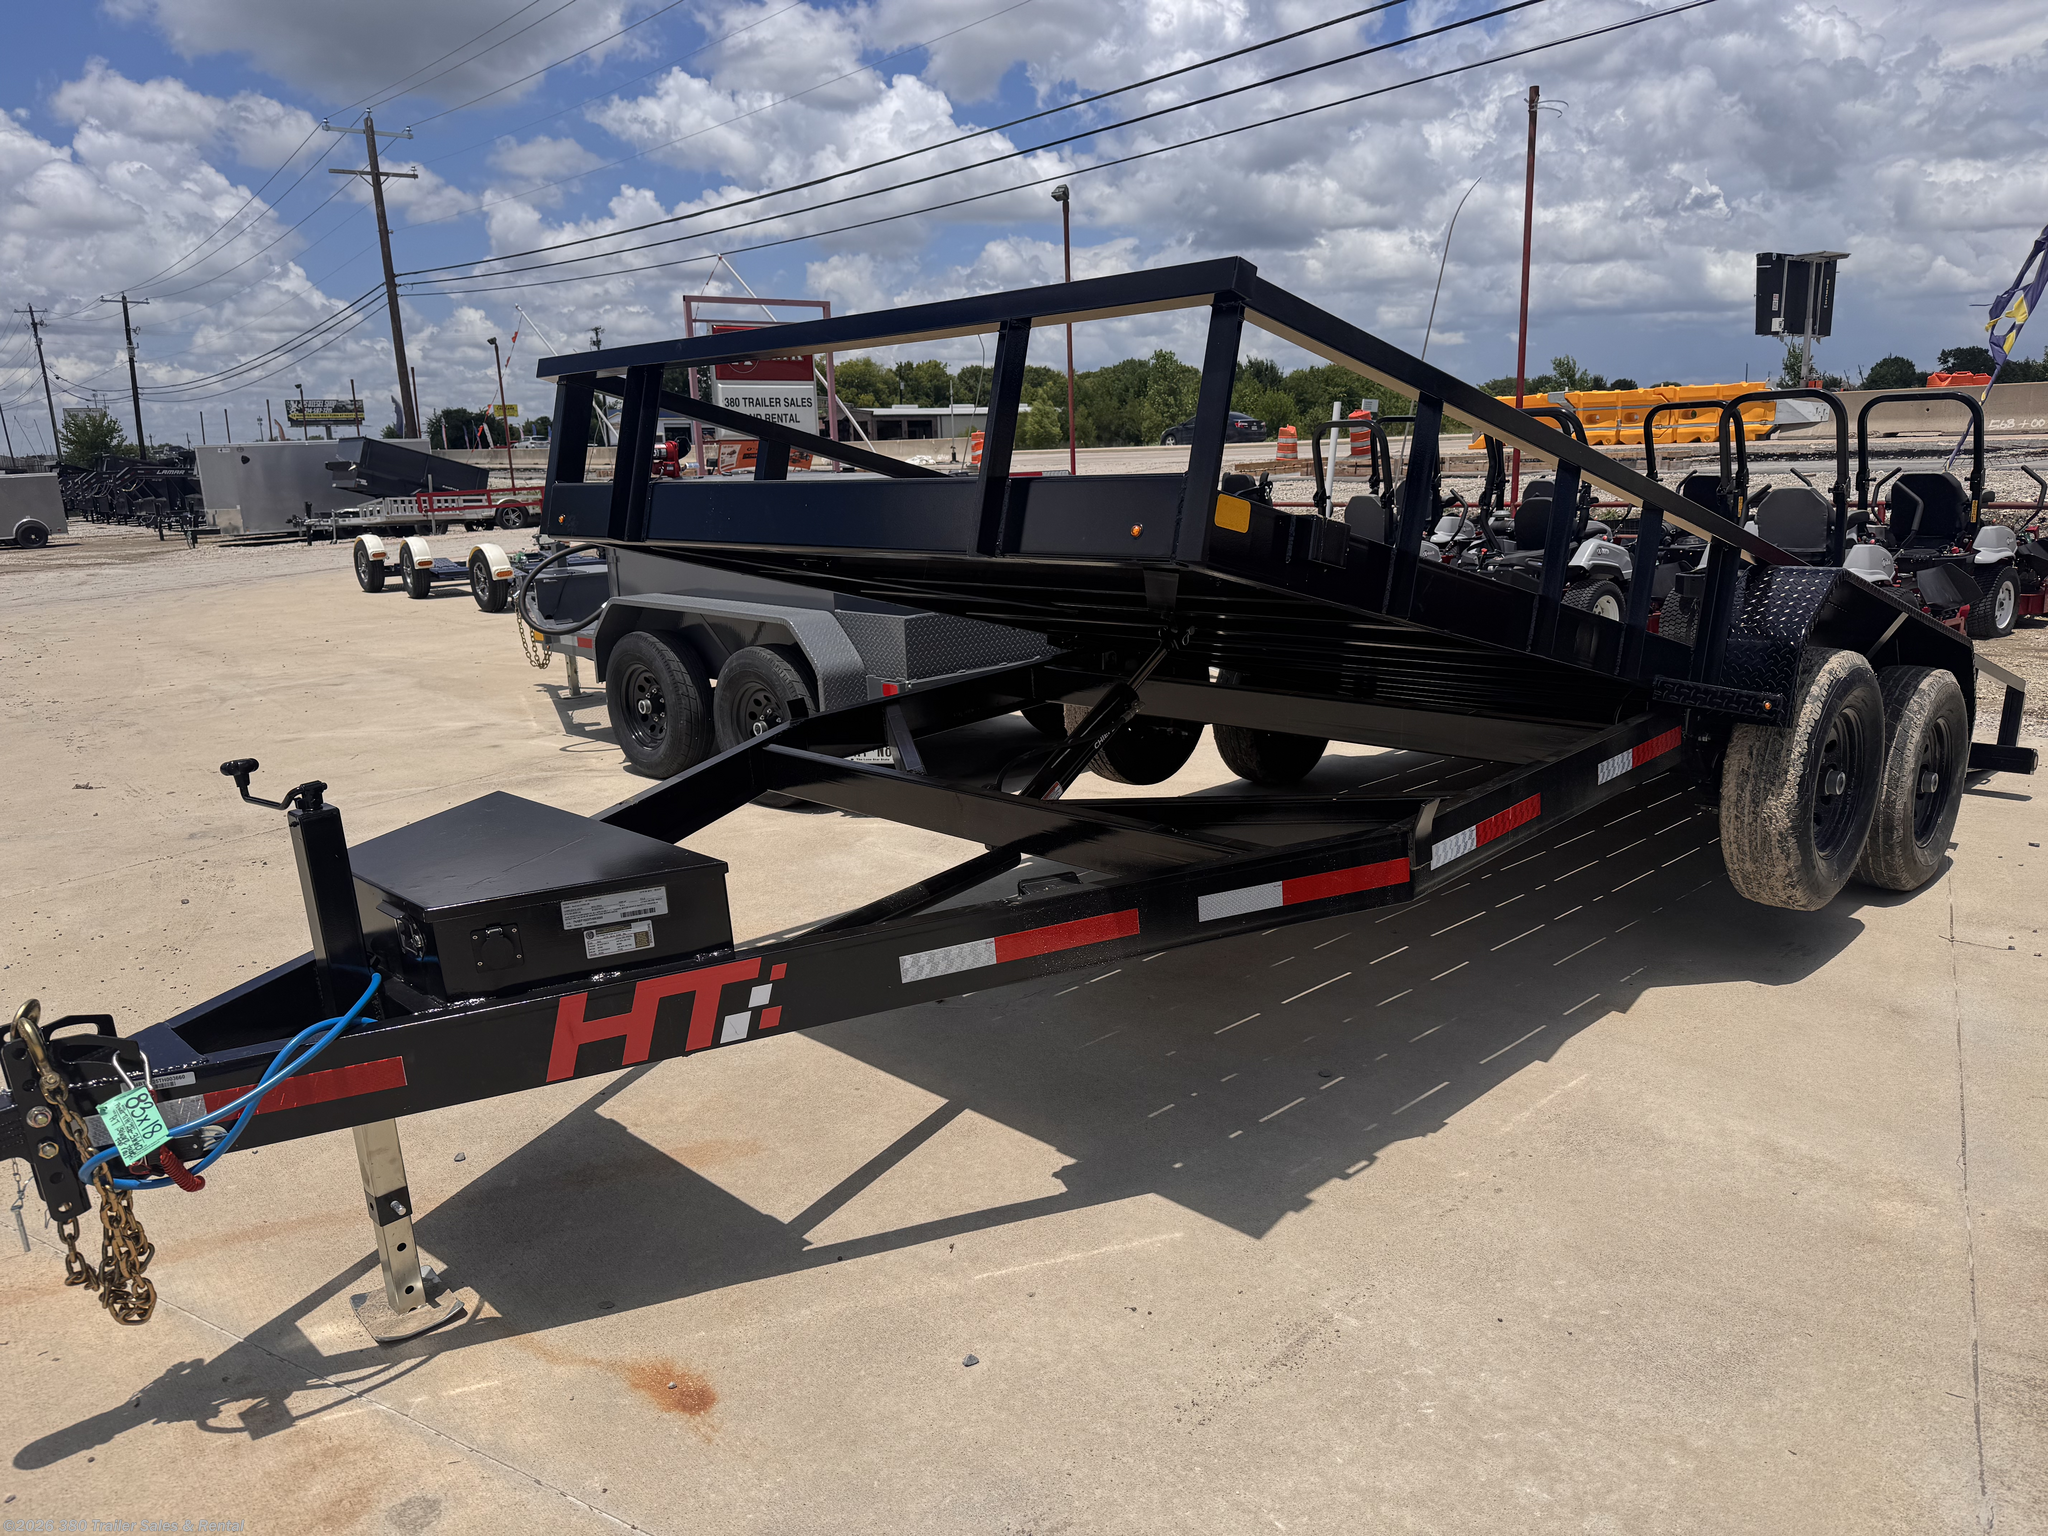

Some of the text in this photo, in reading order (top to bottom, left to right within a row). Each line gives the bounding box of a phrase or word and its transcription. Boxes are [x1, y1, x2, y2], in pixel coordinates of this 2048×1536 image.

[724, 397, 813, 408] 380 TRAILER SALES
[765, 413, 801, 424] RENTAL
[1988, 418, 2015, 431] 568
[546, 957, 762, 1082] HT
[125, 1092, 163, 1140] 83x18
